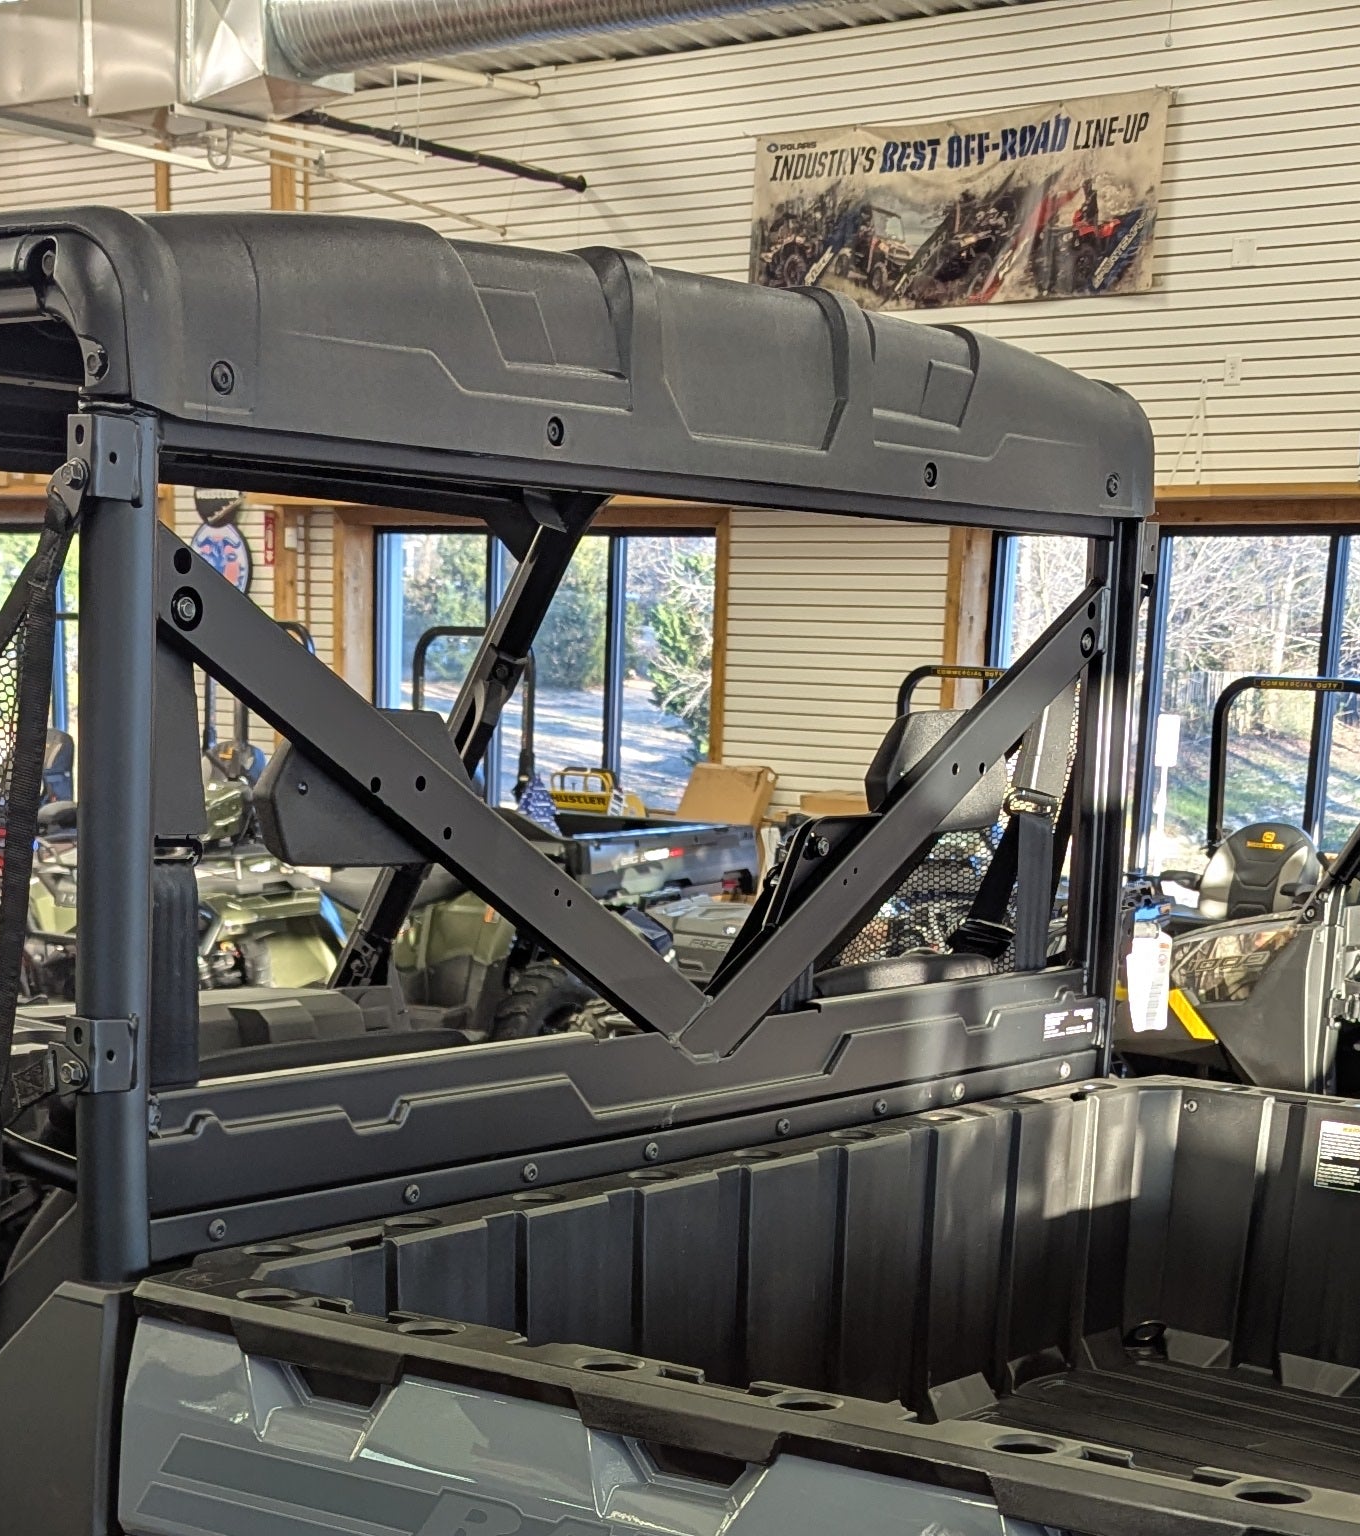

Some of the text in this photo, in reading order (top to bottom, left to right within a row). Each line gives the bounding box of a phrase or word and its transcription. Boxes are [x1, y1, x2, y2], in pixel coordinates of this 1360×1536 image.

[769, 112, 1150, 182] INDUSTRY'S BEST OFF-ROAD LINE-UP
[780, 141, 817, 150] POLARIS
[1260, 680, 1313, 689] COMMERCIAL
